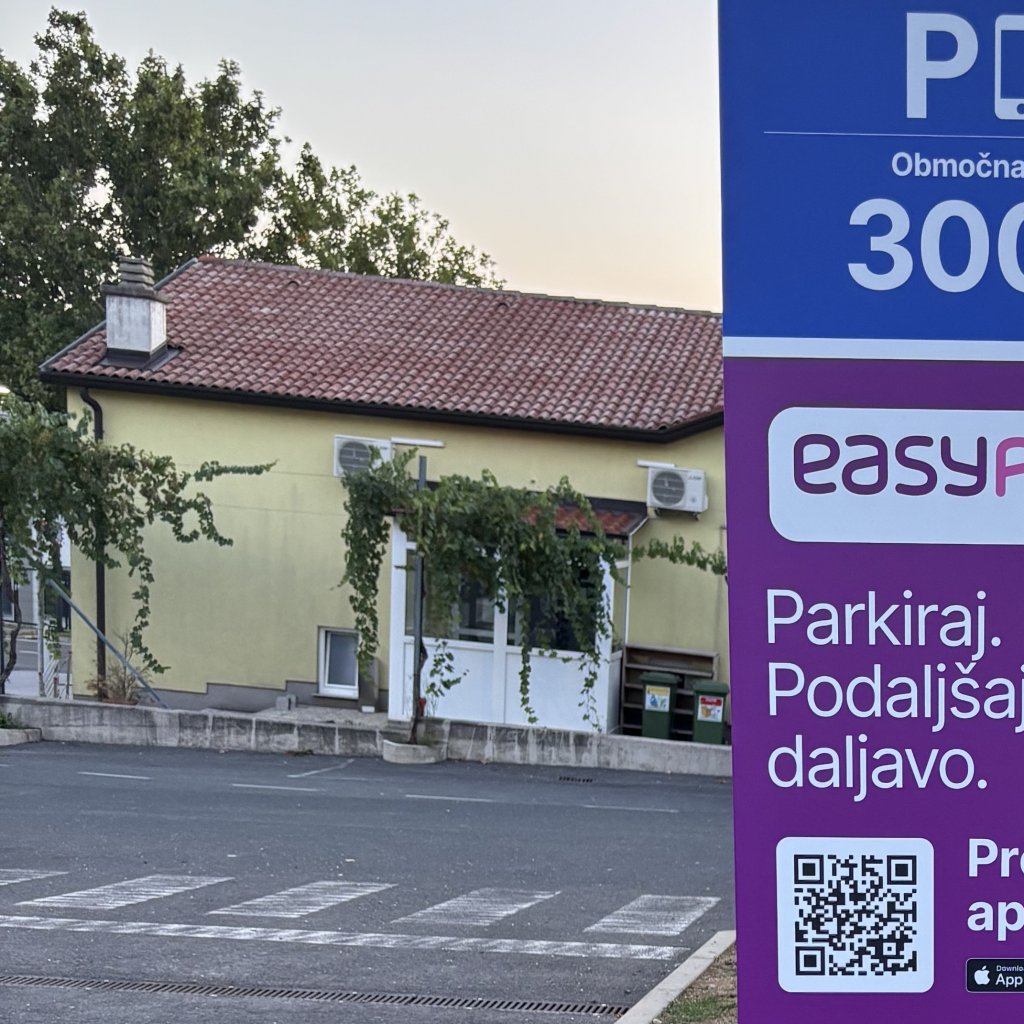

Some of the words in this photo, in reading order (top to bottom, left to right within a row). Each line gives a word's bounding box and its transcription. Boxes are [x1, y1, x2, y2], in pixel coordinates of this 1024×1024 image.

[906, 12, 979, 118] P
[766, 588, 1001, 662] Parkiraj.
[767, 733, 988, 802] daljavo.
[995, 974, 1024, 987] App
